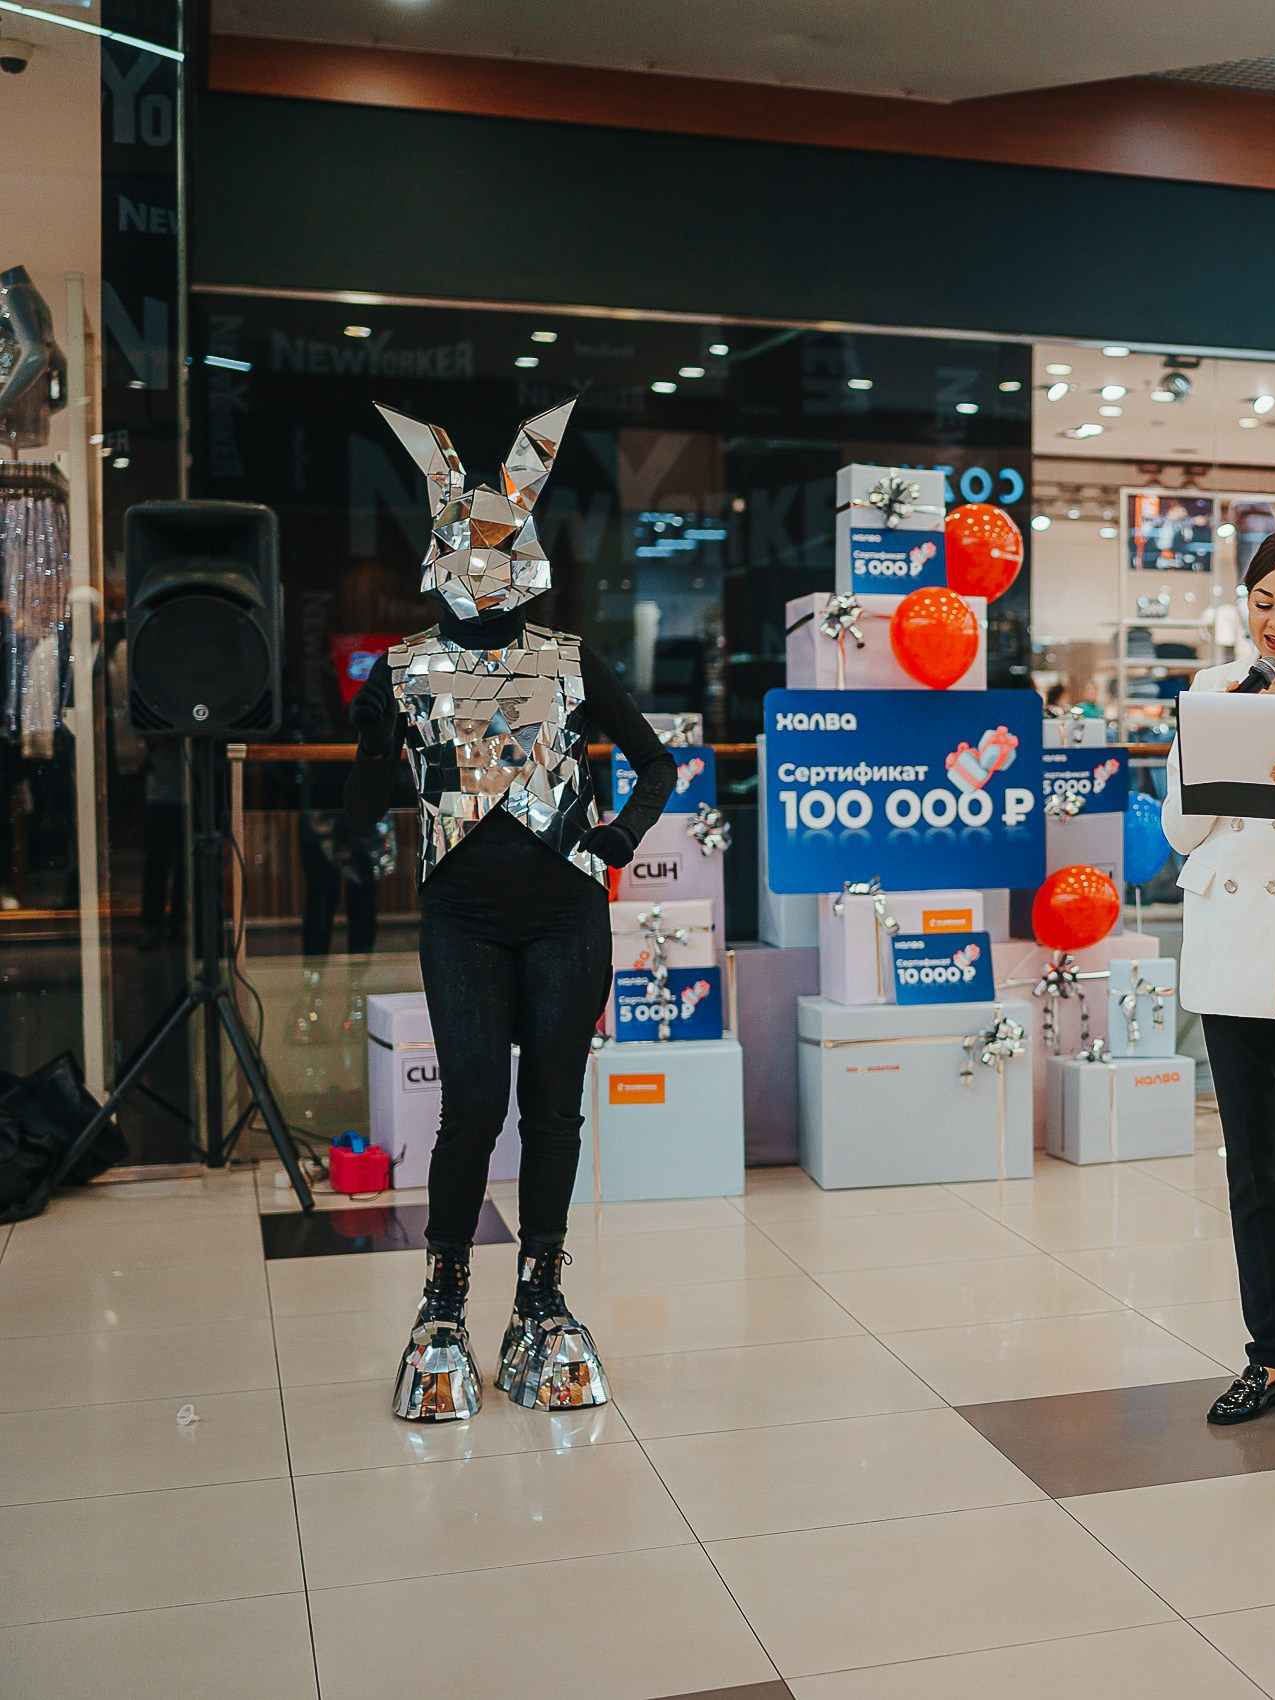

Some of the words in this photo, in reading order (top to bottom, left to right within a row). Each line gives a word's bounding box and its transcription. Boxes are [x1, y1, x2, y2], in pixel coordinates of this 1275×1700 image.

[777, 761, 929, 786] Сертификат
[779, 789, 874, 829] 100
[885, 788, 993, 828] 000
